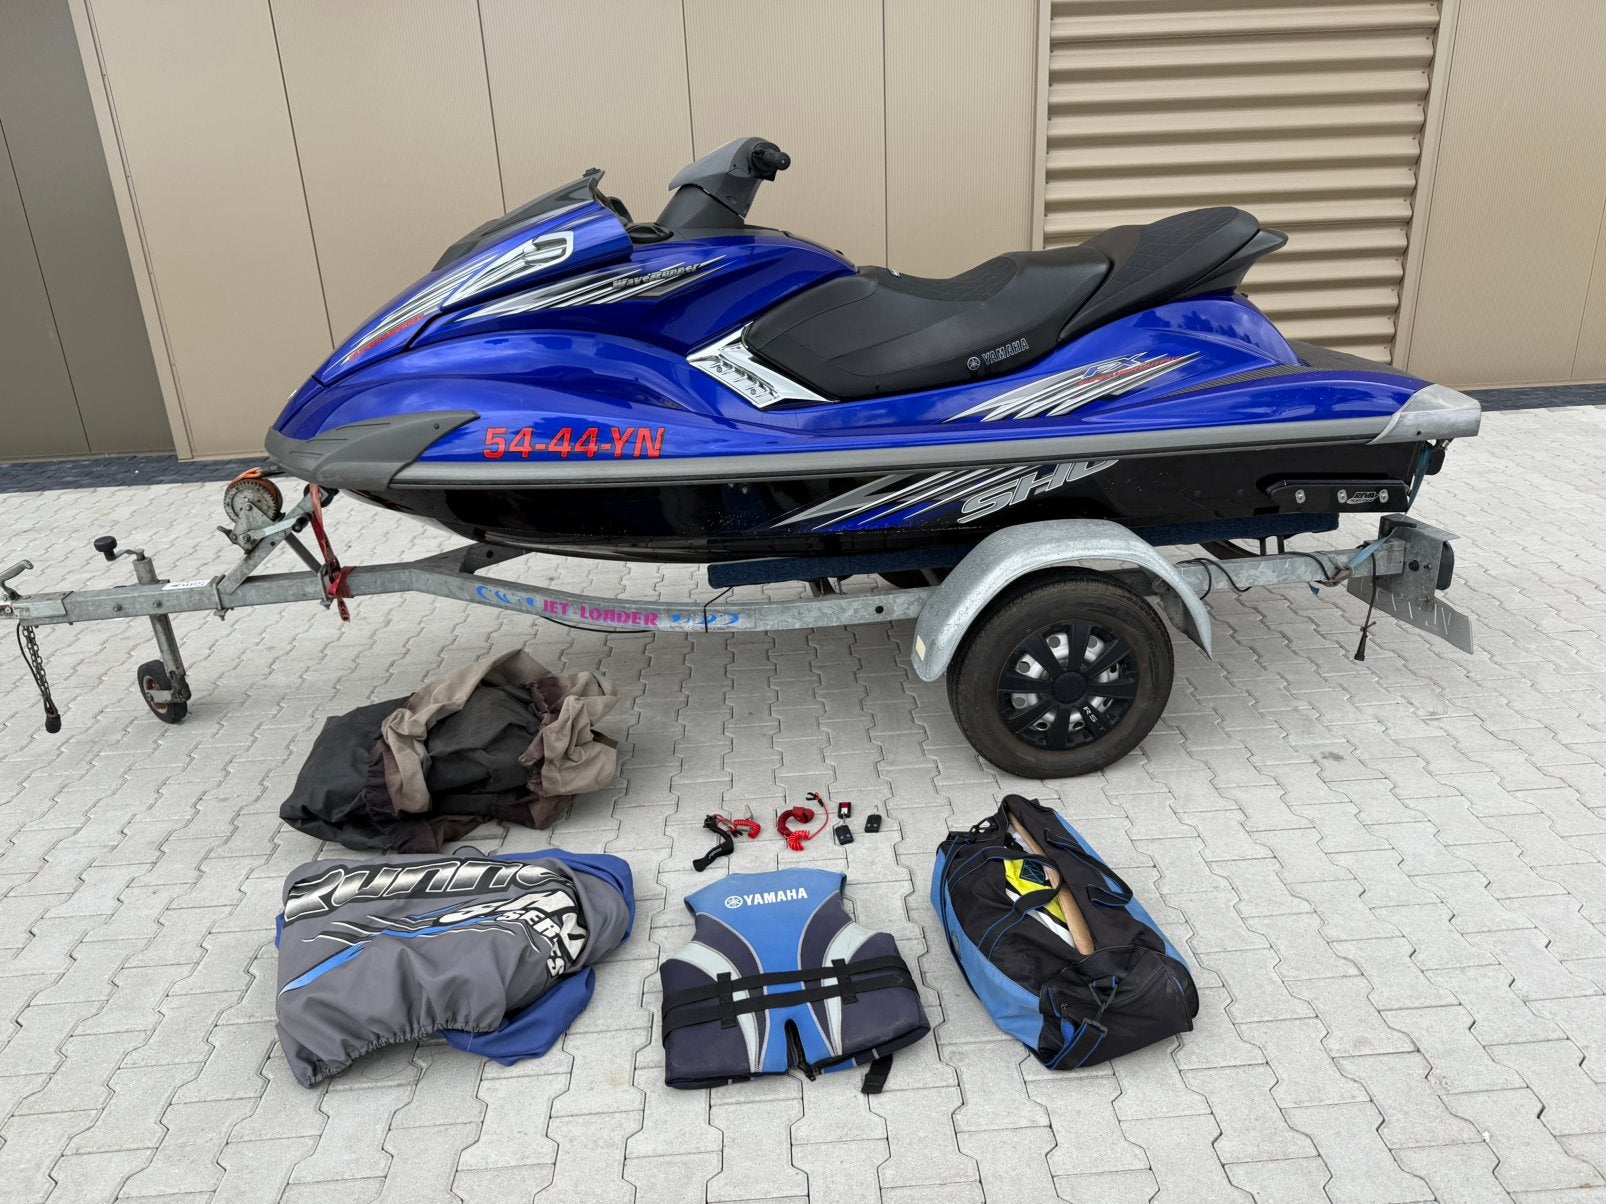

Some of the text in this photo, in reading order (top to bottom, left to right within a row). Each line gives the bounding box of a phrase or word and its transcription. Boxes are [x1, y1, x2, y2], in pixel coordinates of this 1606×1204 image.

[982, 338, 1030, 366] YAMAHA
[482, 427, 666, 460] 54-44-YN
[580, 605, 659, 627] LOADER
[1083, 706, 1098, 723] RS
[743, 887, 809, 906] YAMAHA
